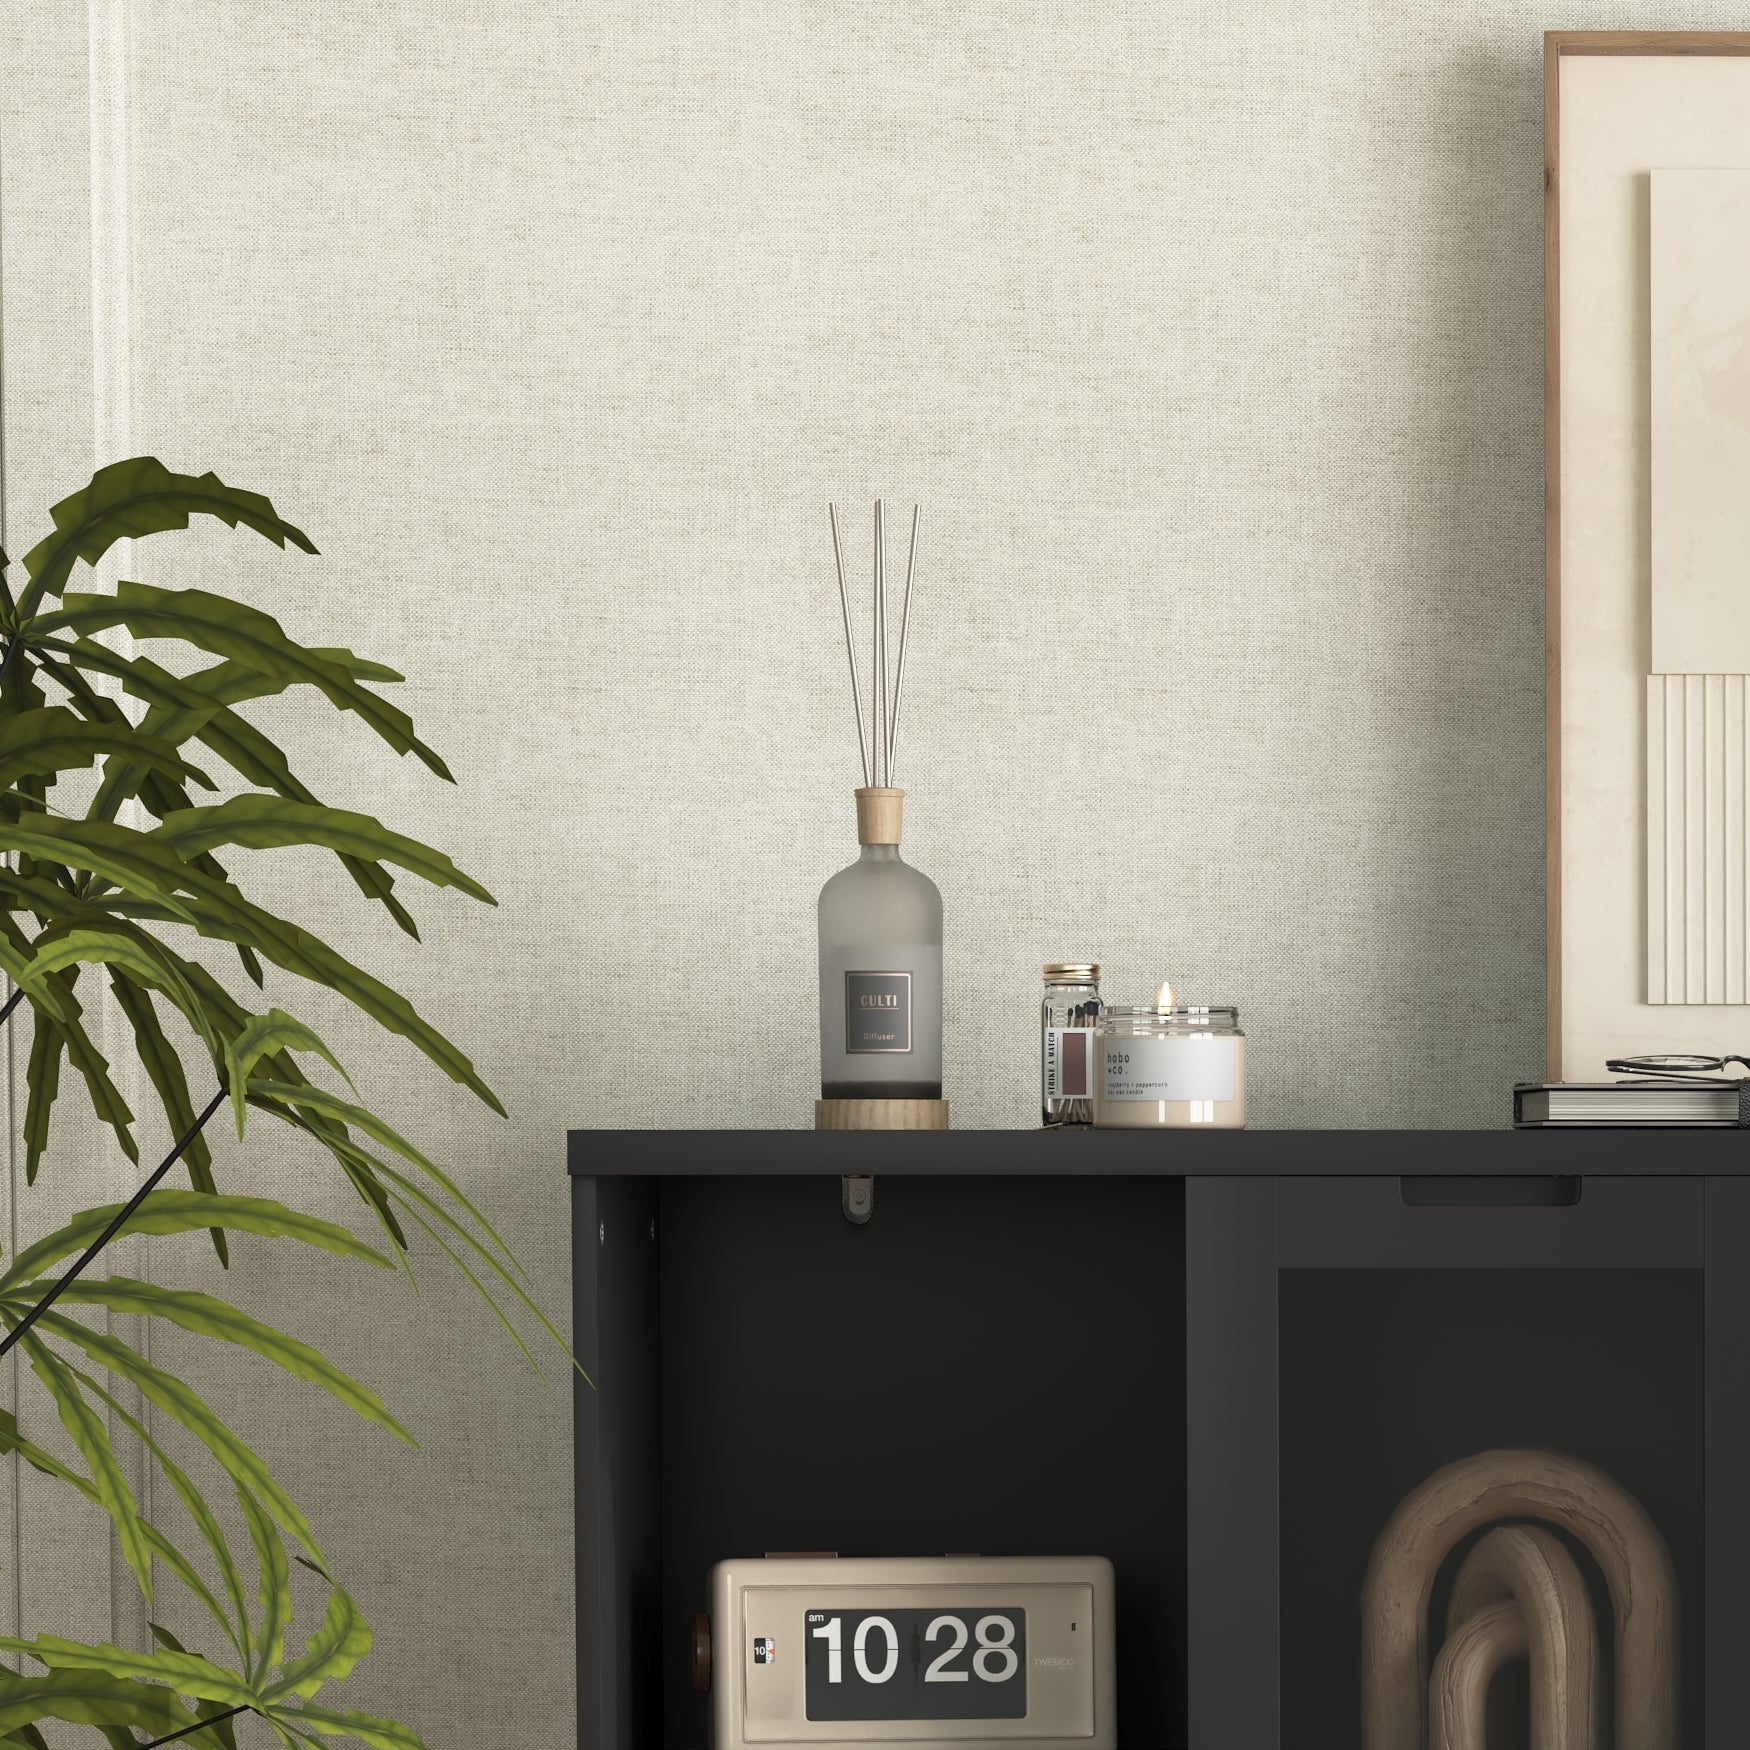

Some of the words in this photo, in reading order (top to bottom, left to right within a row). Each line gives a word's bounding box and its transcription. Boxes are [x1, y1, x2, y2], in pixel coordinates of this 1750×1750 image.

[860, 994, 897, 1007] CULTI
[1107, 1052, 1130, 1063] hobo
[808, 1614, 824, 1622] am
[755, 1646, 766, 1656] 10
[813, 1616, 899, 1684] 10
[924, 1615, 1018, 1683] 28
